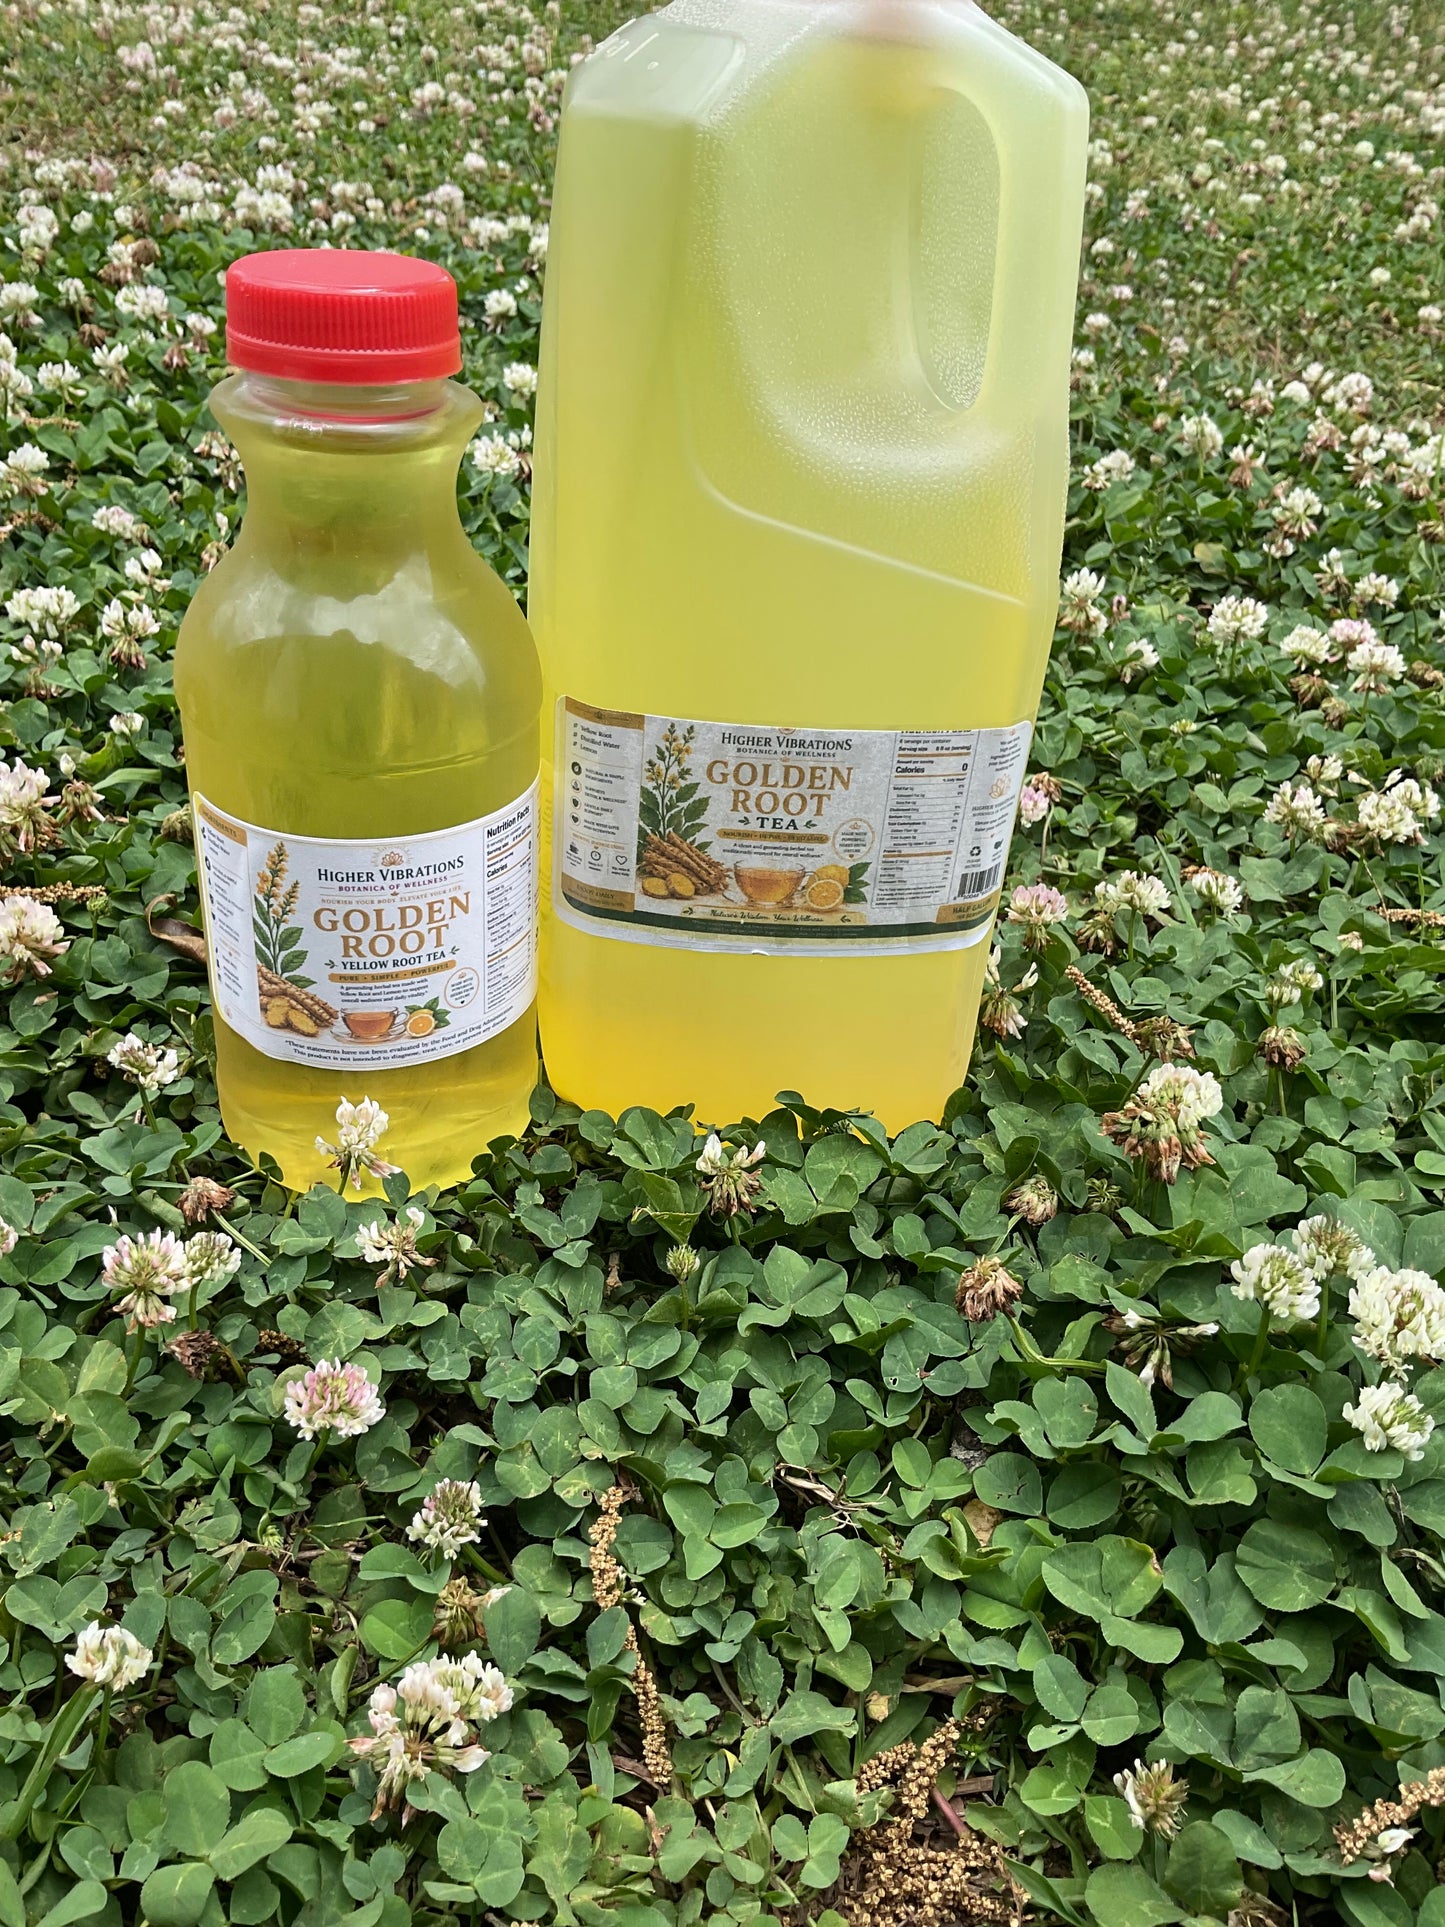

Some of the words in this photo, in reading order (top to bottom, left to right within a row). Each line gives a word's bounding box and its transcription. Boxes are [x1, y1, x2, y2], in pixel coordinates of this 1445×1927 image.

[580, 744, 598, 754] Lemon
[722, 732, 772, 747] HIGHER
[776, 736, 852, 751] VIBRATIONS
[736, 747, 778, 756] BOTANICA
[796, 750, 836, 758] WELLNESS
[706, 760, 854, 790] GOLDEN
[896, 766, 925, 774] Calories
[962, 763, 968, 771] 0
[730, 789, 831, 816] ROOT
[487, 816, 516, 839] Nutrition
[516, 805, 530, 822] Facts
[756, 816, 799, 830] TEA
[318, 868, 374, 882] HIGHER
[379, 855, 464, 881] VIBRATIONS
[487, 864, 508, 878] Calories
[338, 884, 385, 892] BOTANICA
[404, 876, 448, 888] WELLNESS
[430, 889, 446, 897] YOUR
[313, 891, 471, 933] GOLDEN
[341, 924, 450, 958] ROOT
[341, 960, 389, 970] YELLOW
[392, 955, 423, 968] ROOT
[426, 950, 446, 962] TEA
[371, 973, 399, 981] SIMPLE
[410, 963, 450, 976] POWERFUL
[442, 1034, 457, 1042] Food
